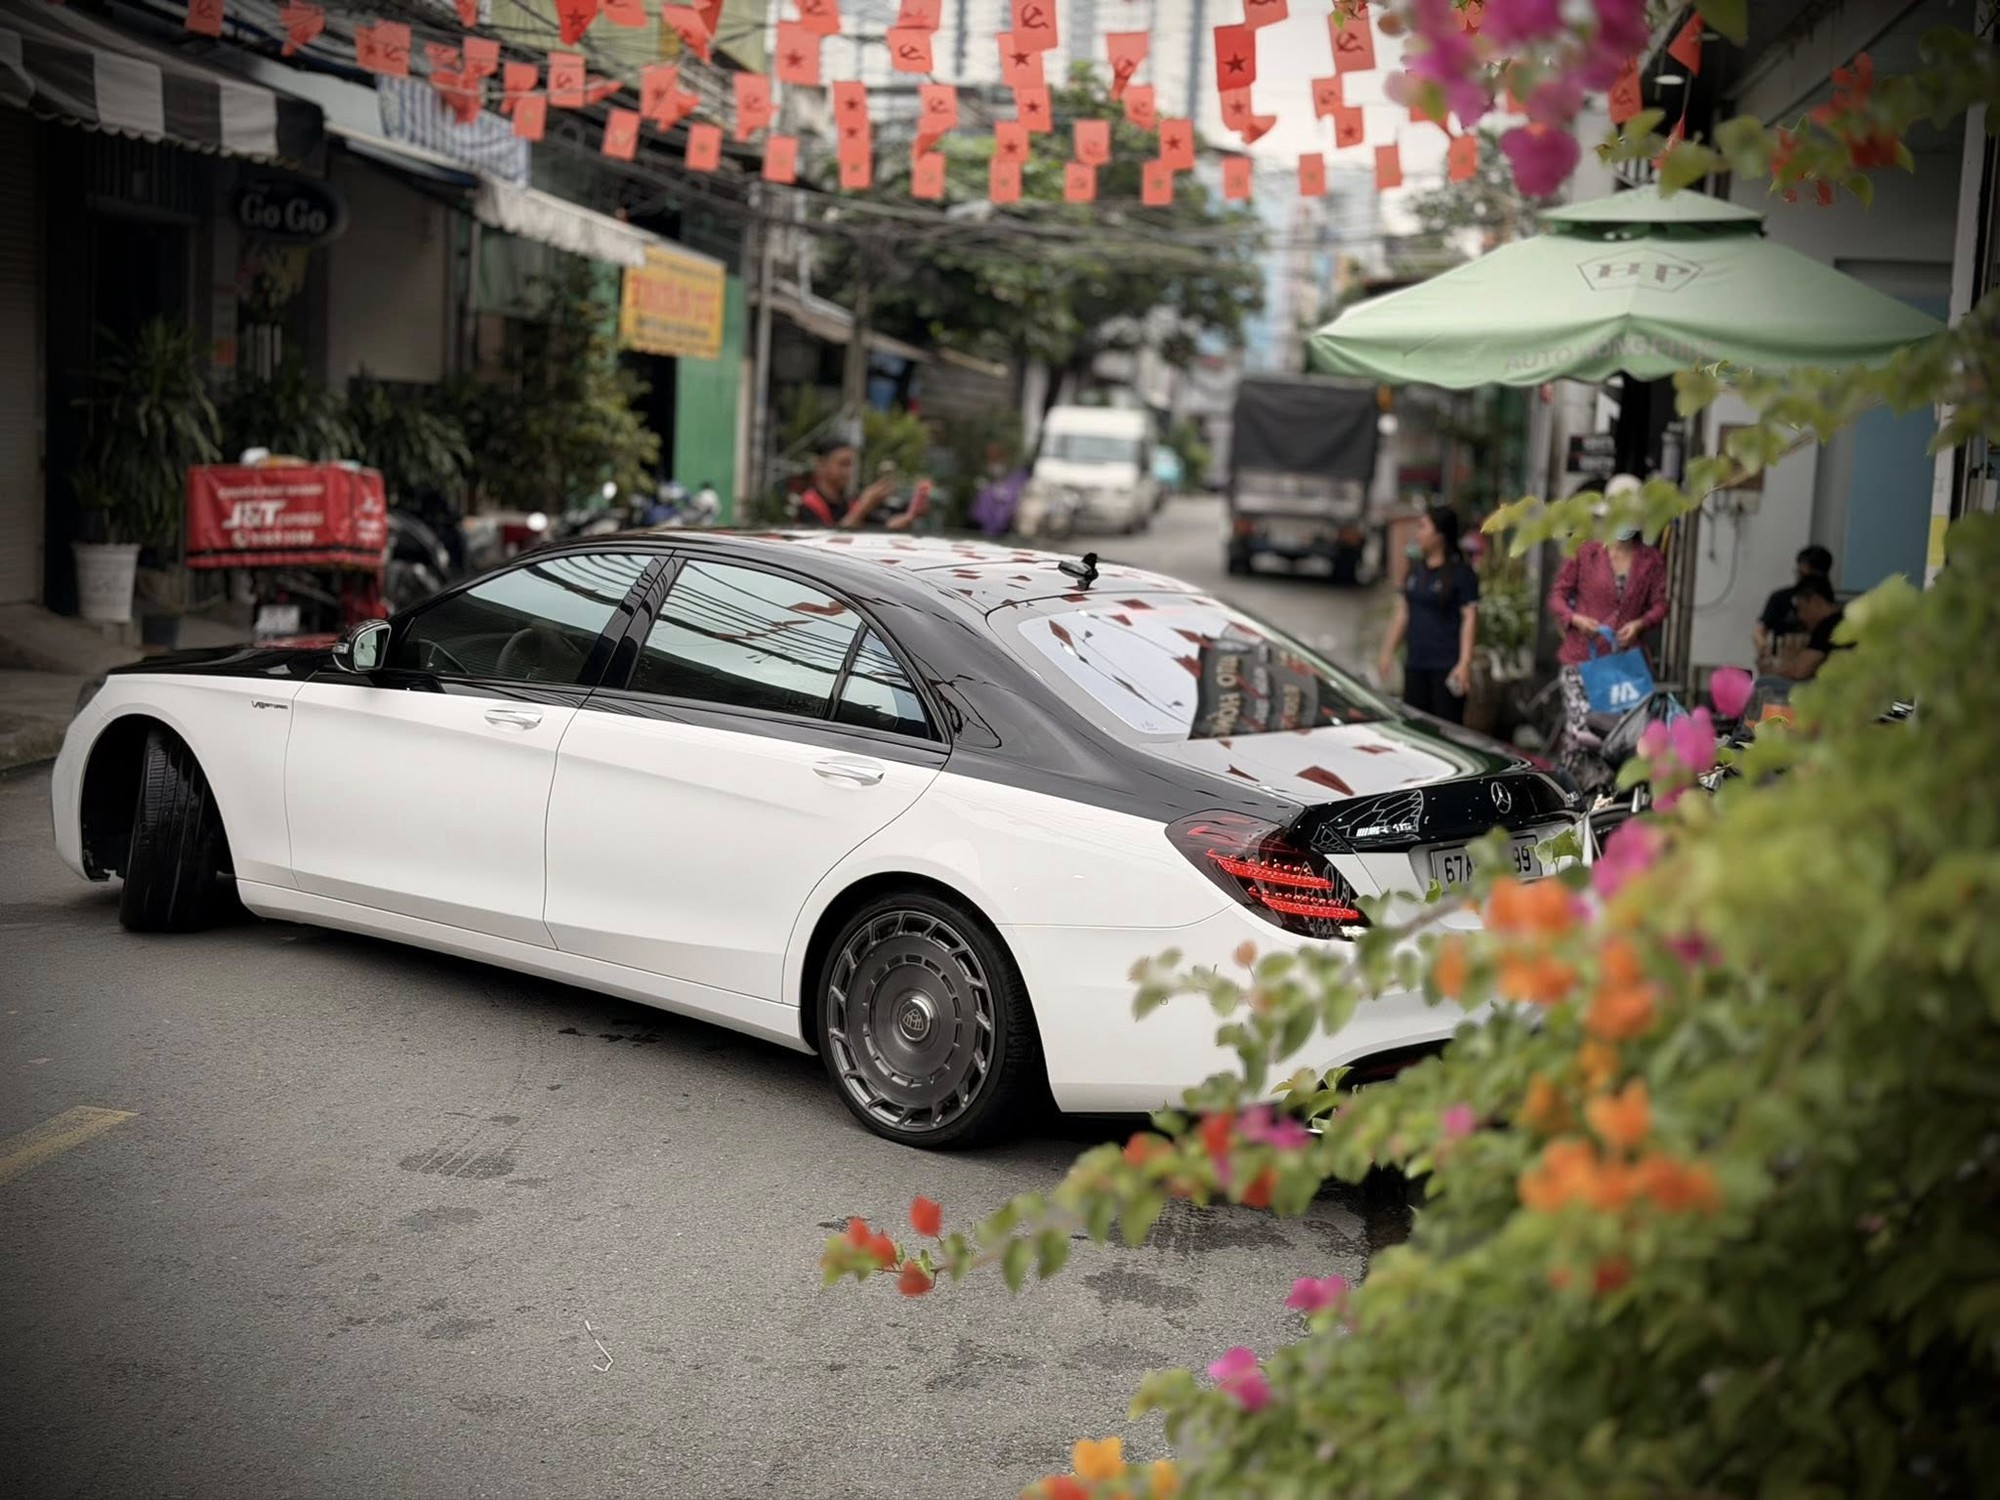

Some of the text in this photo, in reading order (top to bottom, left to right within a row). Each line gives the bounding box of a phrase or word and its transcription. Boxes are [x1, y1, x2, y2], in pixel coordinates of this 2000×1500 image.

[243, 194, 328, 233] Go Go
[1504, 346, 1572, 371] AUTO
[222, 500, 288, 529] J&T
